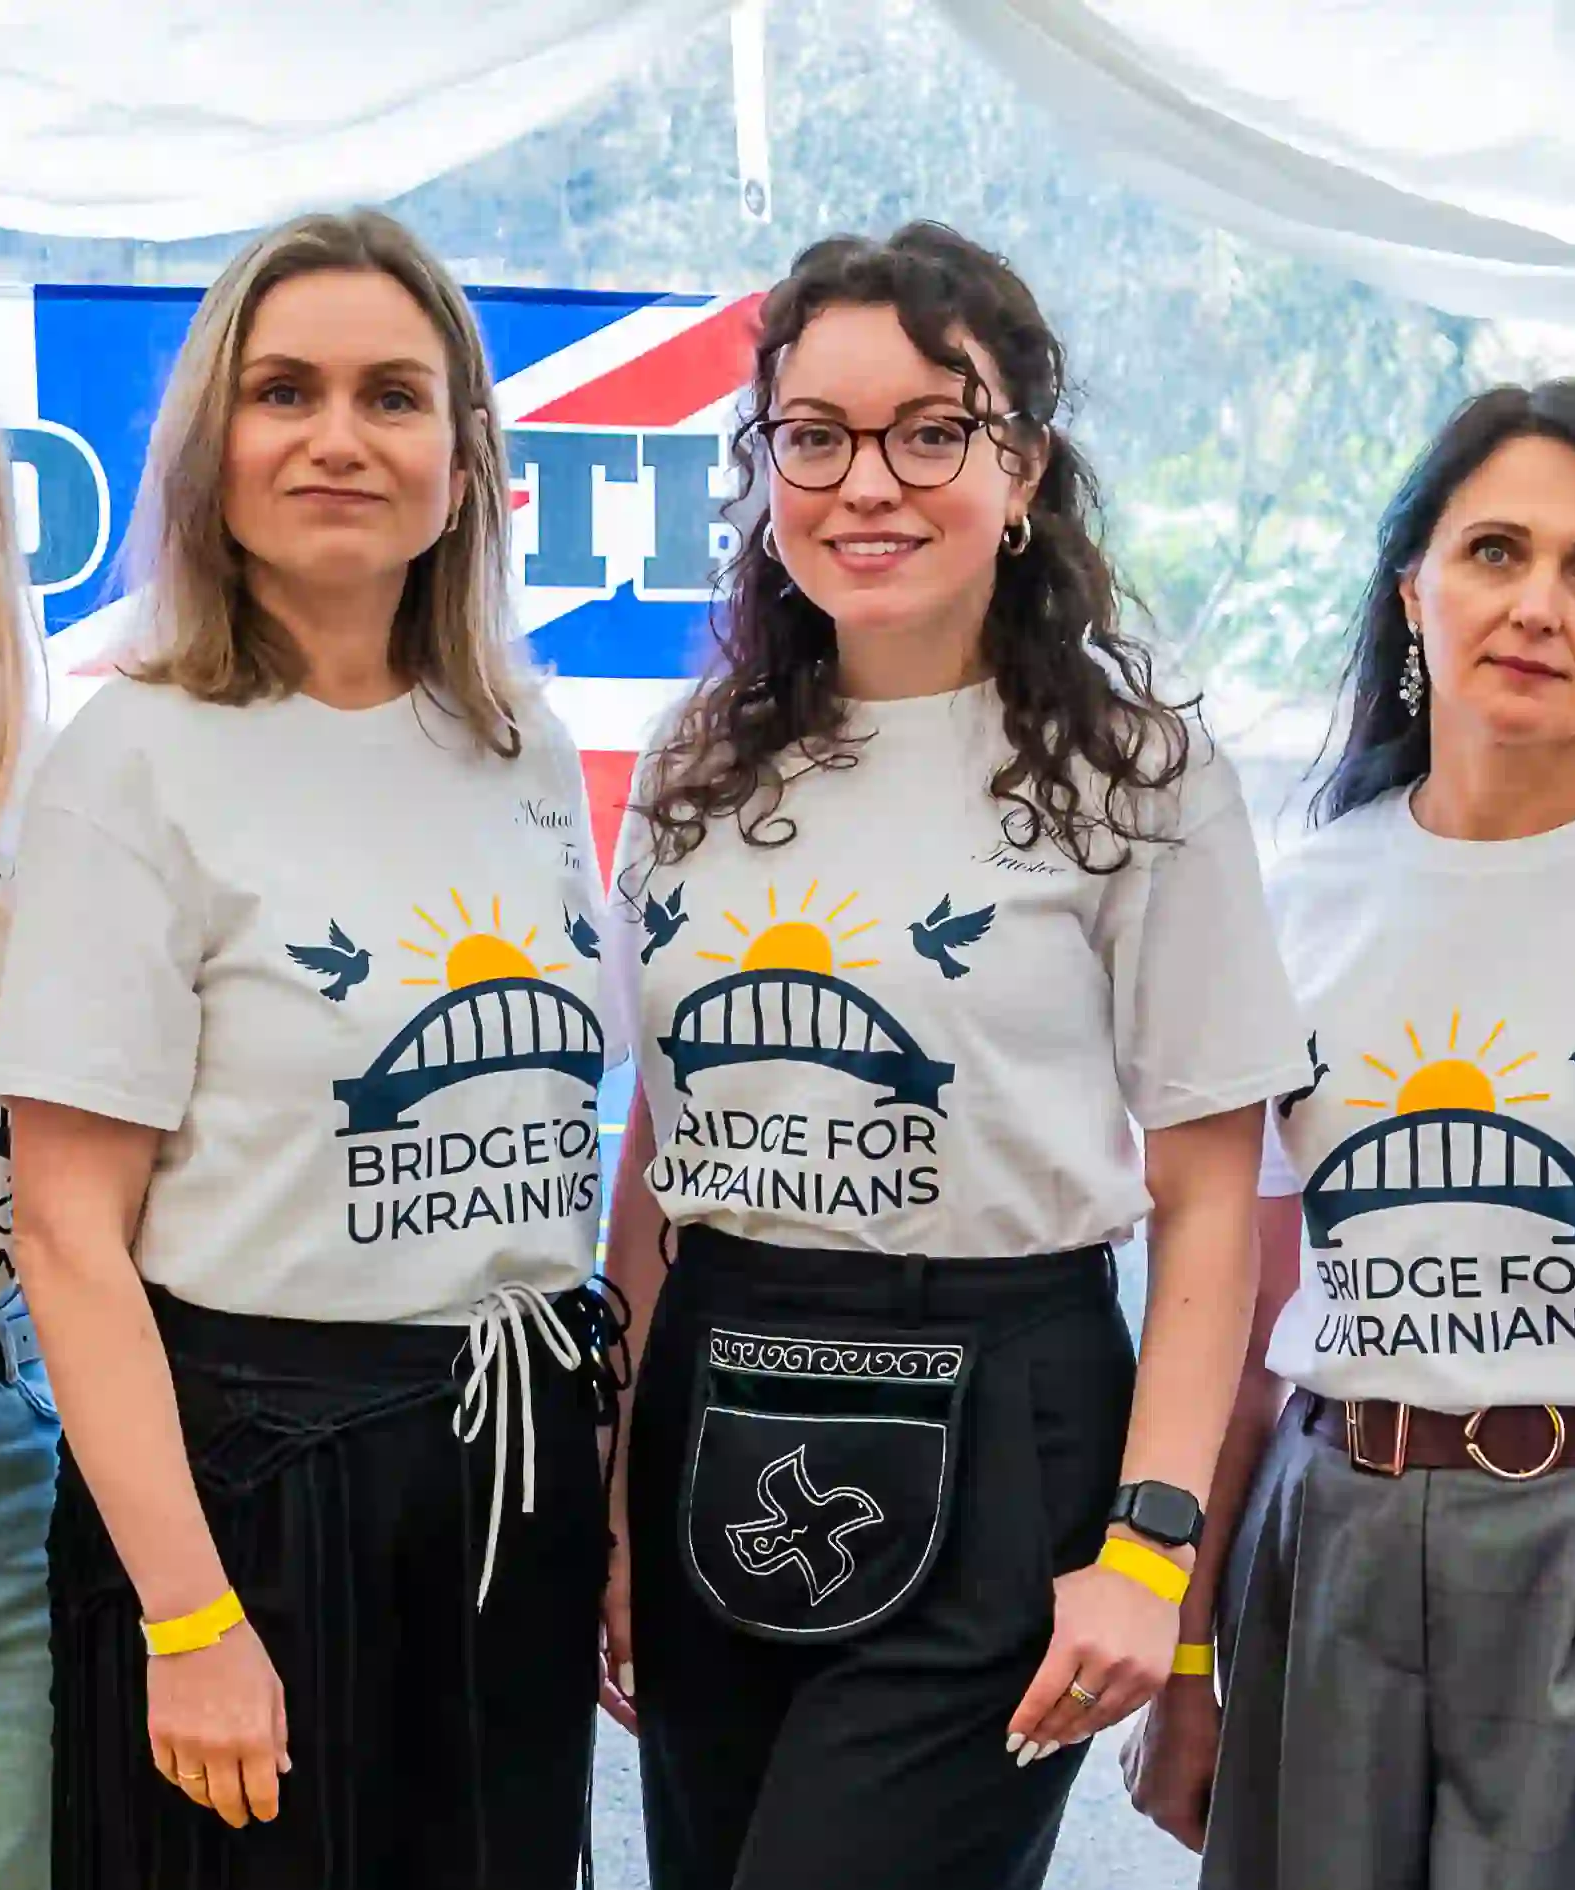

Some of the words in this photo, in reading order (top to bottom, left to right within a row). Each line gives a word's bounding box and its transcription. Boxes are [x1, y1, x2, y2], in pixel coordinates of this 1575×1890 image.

[347, 1122, 549, 1188] BRIDGE
[675, 1107, 808, 1157] RIDGE
[827, 1114, 937, 1161] FOR
[650, 1155, 939, 1217] UKRAINIANS
[1316, 1256, 1482, 1300] BRIDGE
